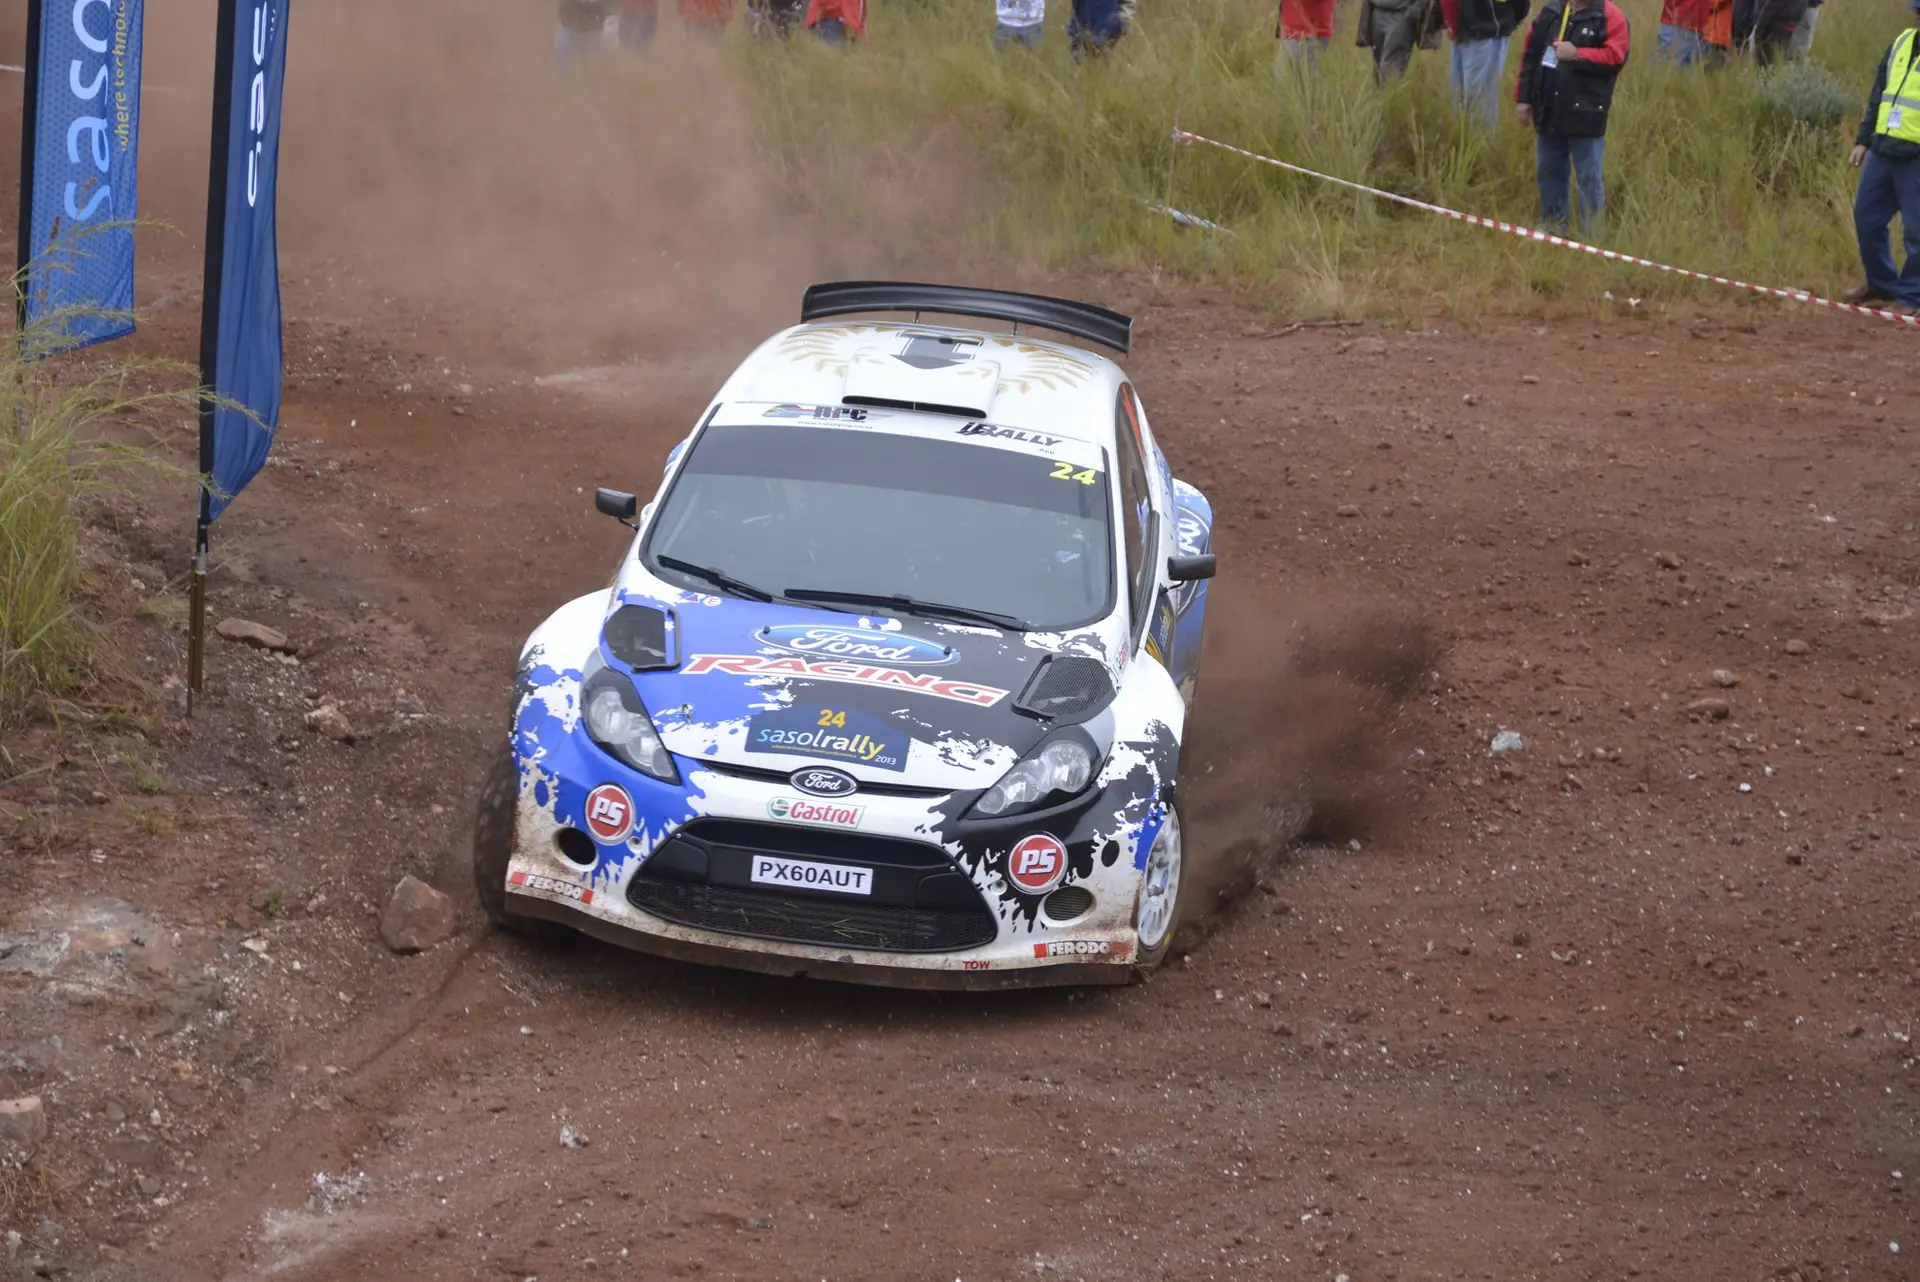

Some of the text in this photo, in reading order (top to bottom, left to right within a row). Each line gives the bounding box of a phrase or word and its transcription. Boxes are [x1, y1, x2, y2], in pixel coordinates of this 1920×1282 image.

[115, 91, 129, 152] where
[1049, 462, 1096, 486] 24
[790, 629, 918, 661] Ford
[682, 654, 1008, 706] RACING
[816, 709, 847, 728] 24
[757, 728, 885, 760] sasolrally
[875, 754, 897, 765] 2013
[804, 772, 840, 791] Ford
[591, 796, 626, 827] PS
[790, 801, 858, 825] Castrol
[759, 861, 867, 888] PX60AUT
[1018, 848, 1058, 875] PS
[1048, 941, 1110, 956] FERODO
[963, 960, 990, 970] TOW
